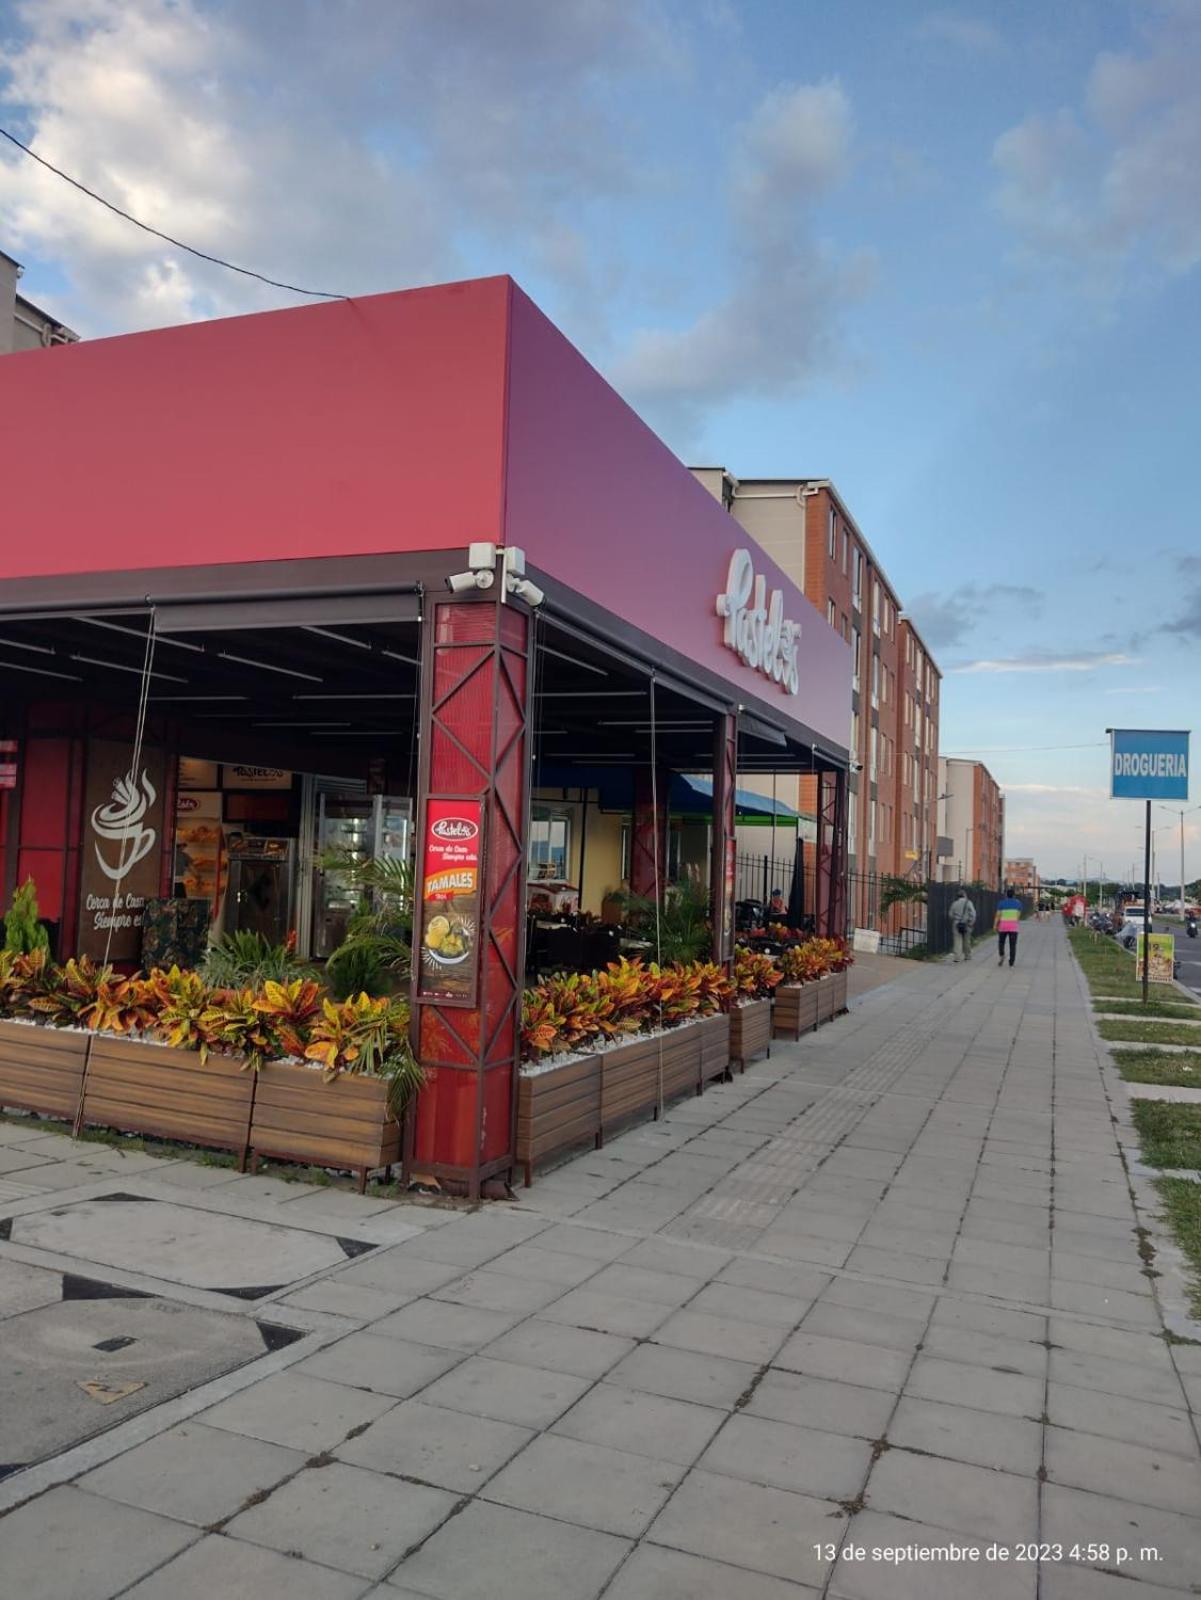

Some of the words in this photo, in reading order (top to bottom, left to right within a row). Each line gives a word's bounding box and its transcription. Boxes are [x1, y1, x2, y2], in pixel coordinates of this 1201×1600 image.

[1114, 752, 1187, 777] DROGUERIA
[427, 871, 473, 893] TAMALES
[86, 893, 110, 910] Cerca
[93, 911, 132, 933] Siempre
